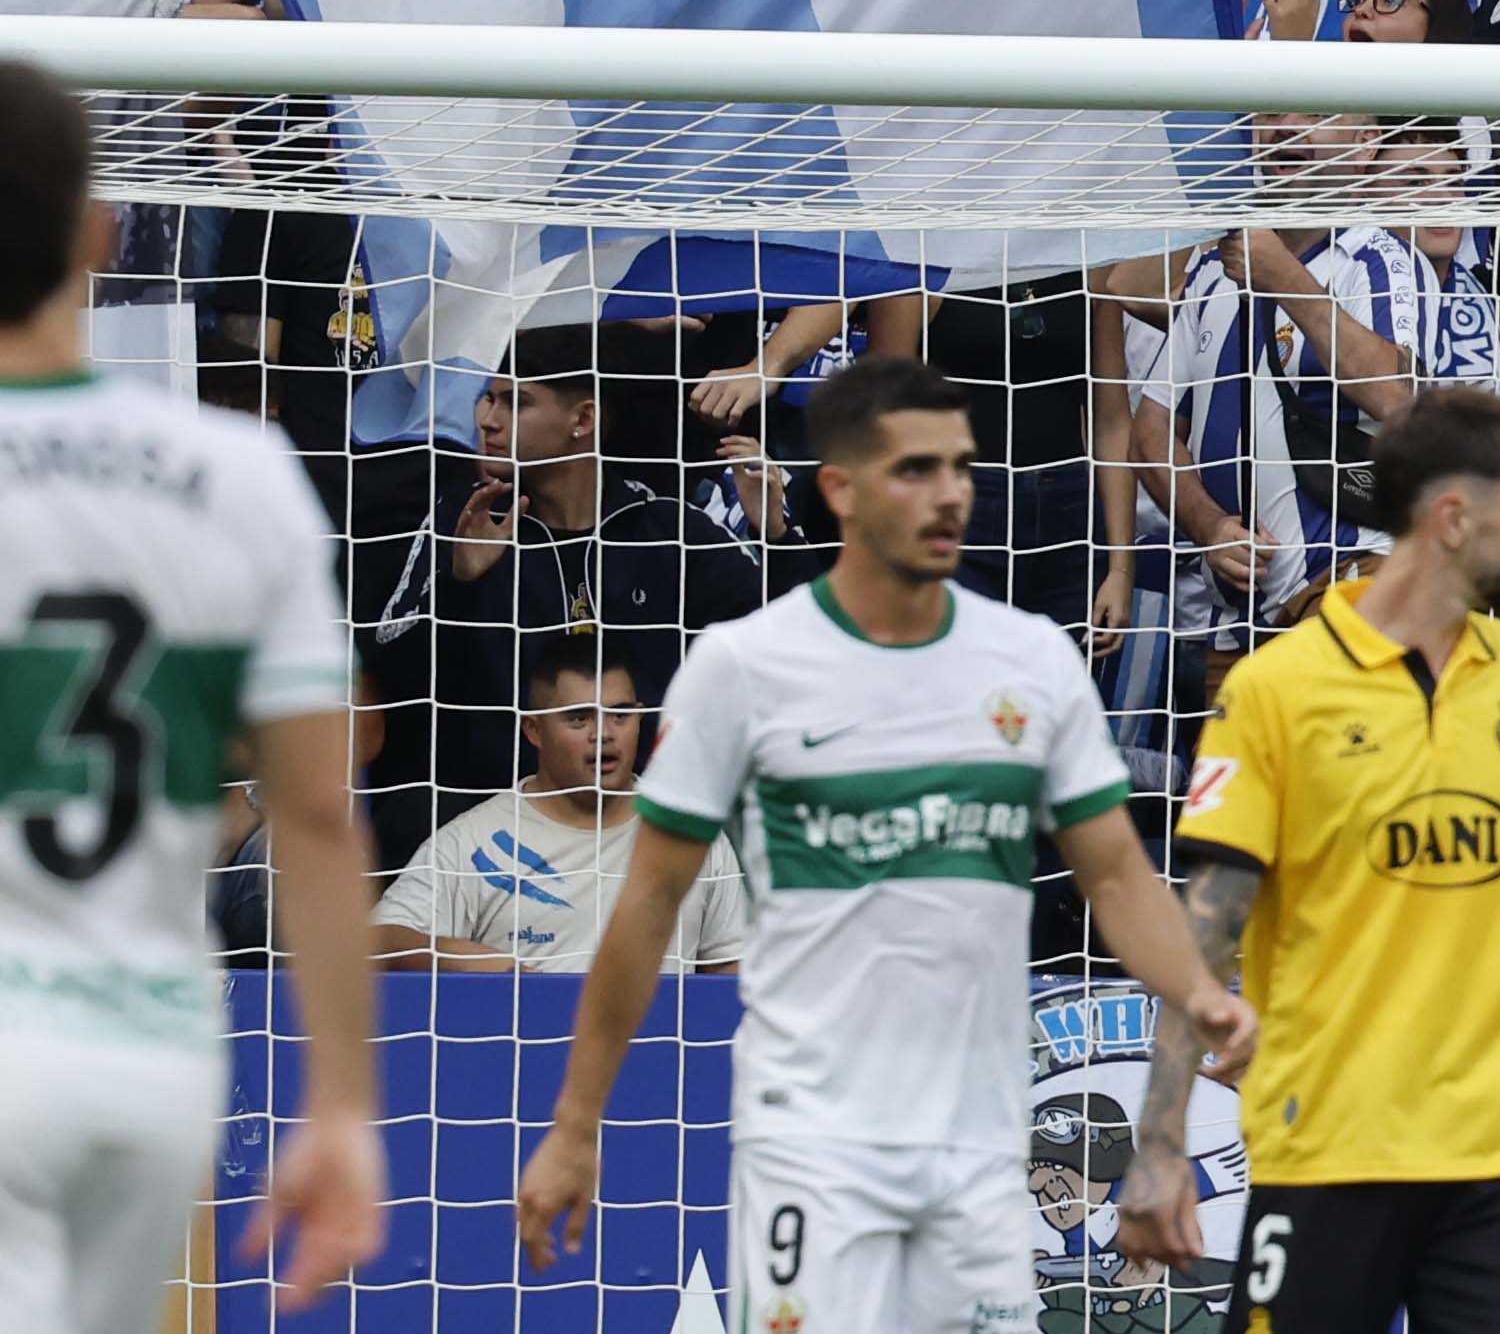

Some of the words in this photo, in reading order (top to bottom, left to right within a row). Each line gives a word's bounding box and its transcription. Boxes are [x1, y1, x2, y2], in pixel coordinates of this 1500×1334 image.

[20, 592, 152, 883] 3
[1385, 814, 1500, 871] DANI
[768, 1203, 805, 1287] 9
[1246, 1212, 1296, 1304] 5
